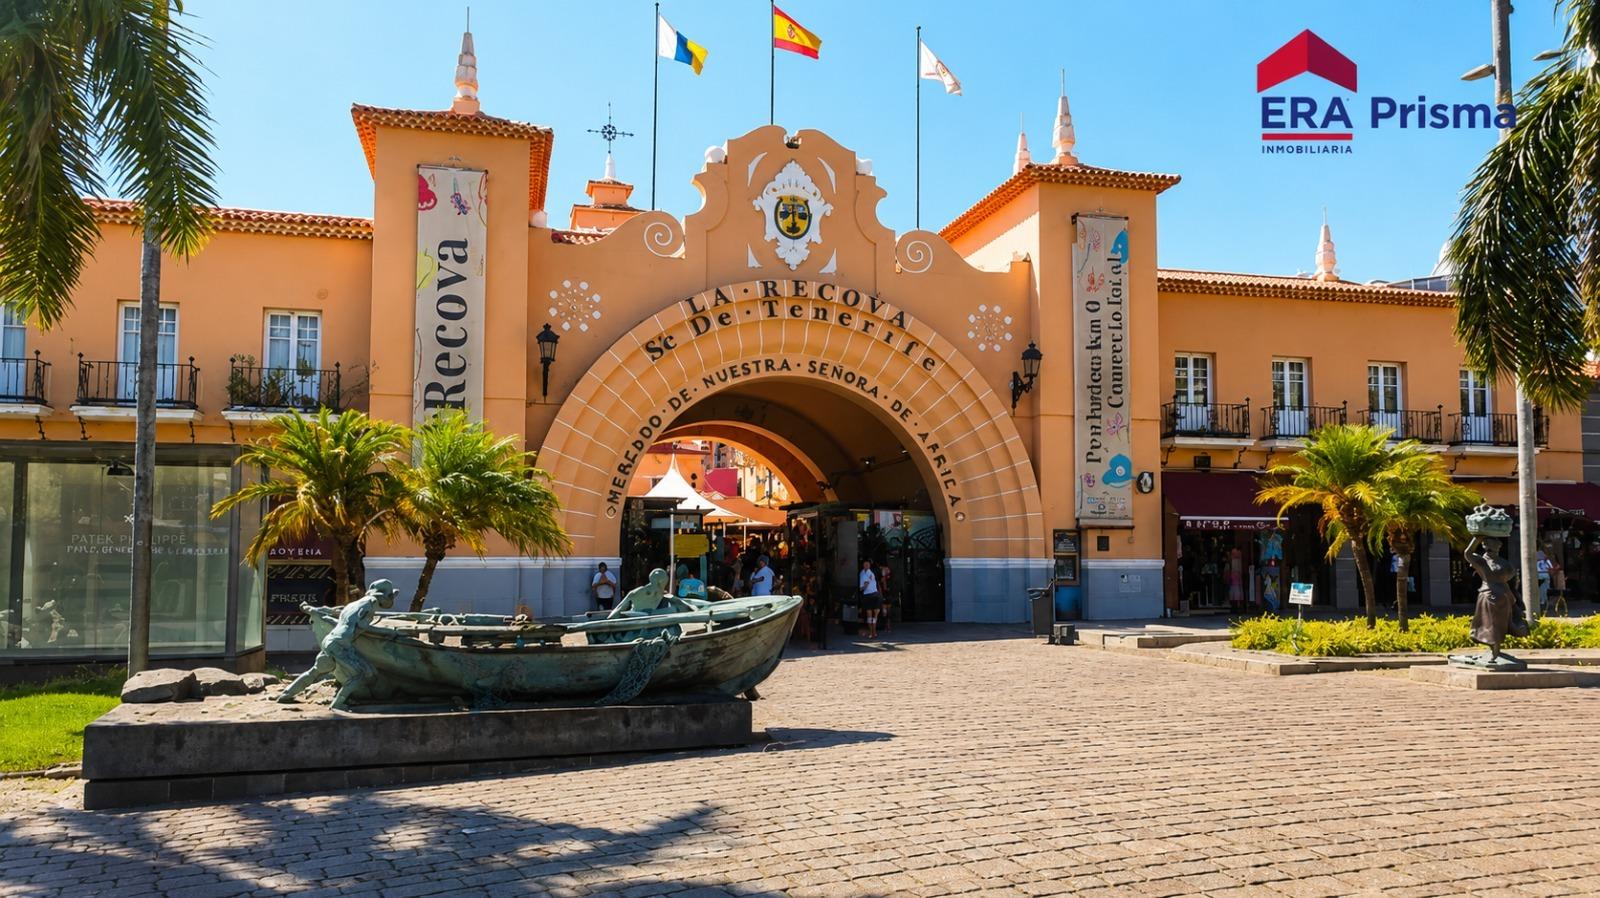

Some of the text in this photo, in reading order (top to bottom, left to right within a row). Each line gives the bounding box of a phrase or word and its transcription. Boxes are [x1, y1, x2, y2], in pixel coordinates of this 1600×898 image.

[424, 237, 469, 414] Recova
[685, 280, 906, 330] LA RECOVA
[690, 311, 732, 336] De
[762, 300, 935, 371] Tenerife
[667, 388, 693, 412] DE
[702, 359, 791, 389] NUESTRA
[808, 360, 878, 399] SEÑORA
[890, 400, 913, 422] DE
[71, 534, 114, 545] PATEK
